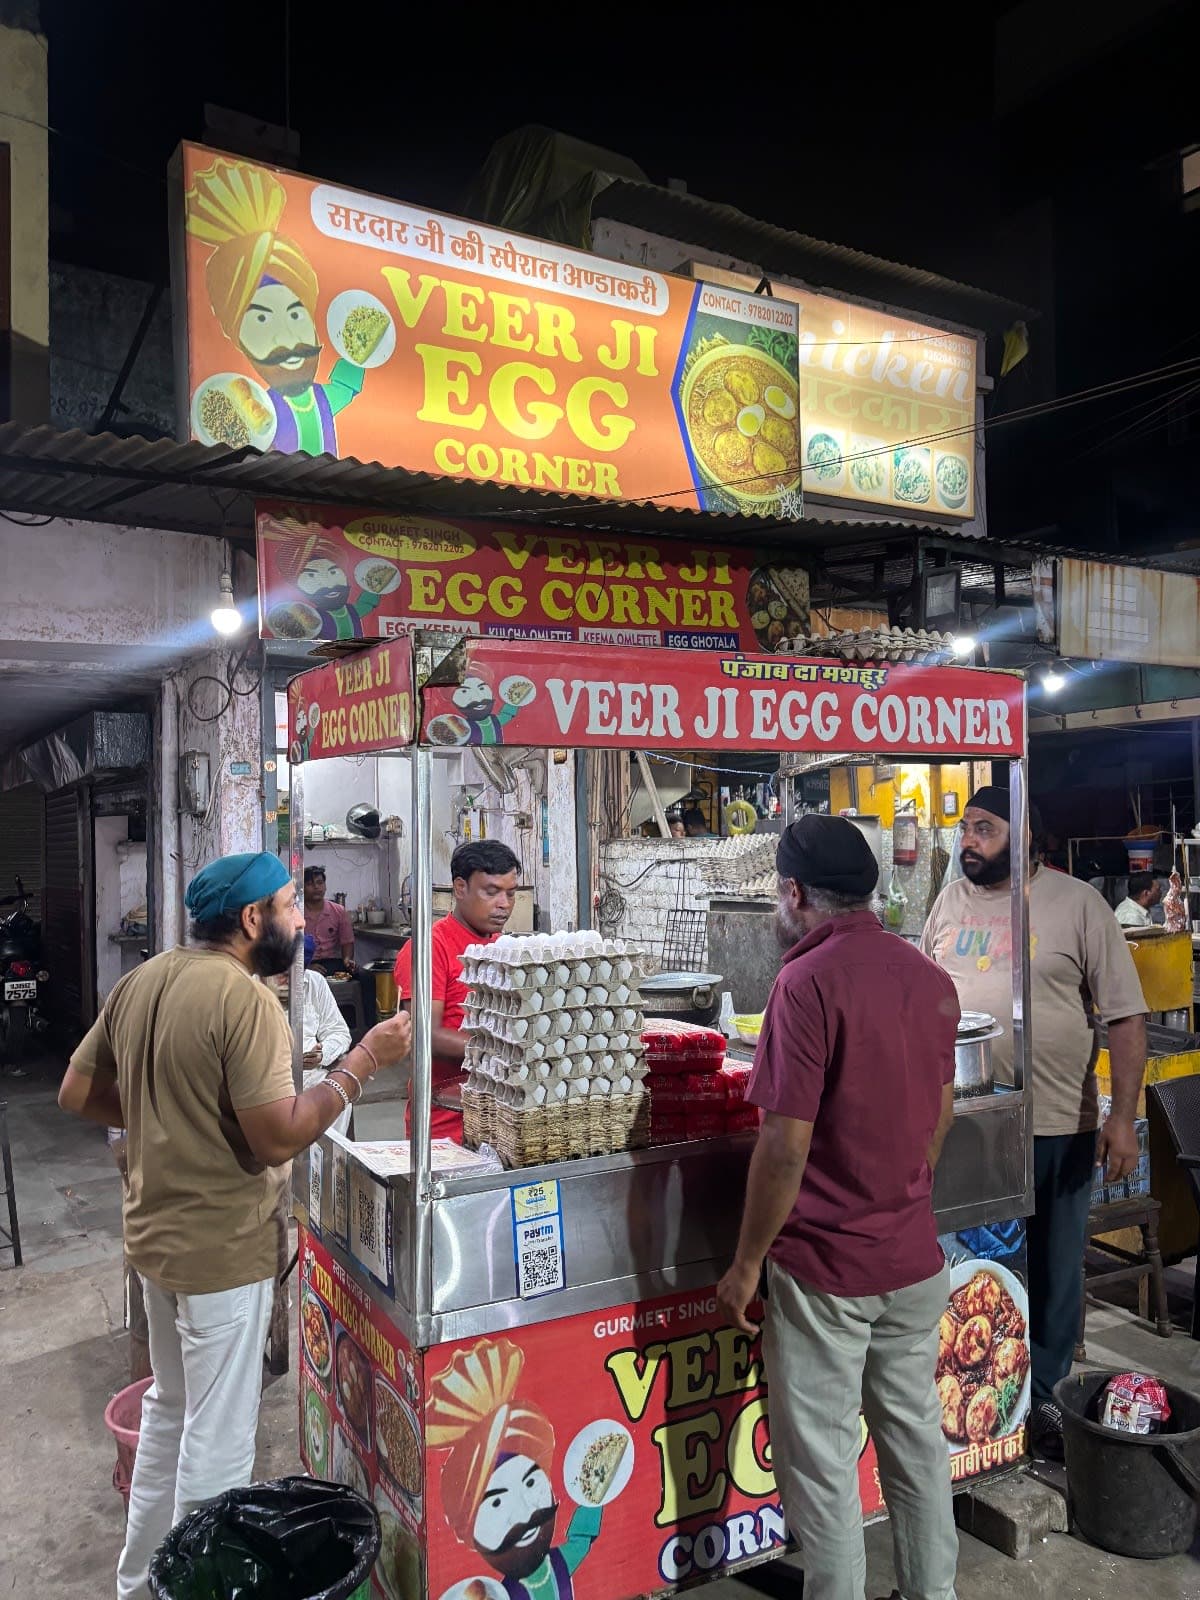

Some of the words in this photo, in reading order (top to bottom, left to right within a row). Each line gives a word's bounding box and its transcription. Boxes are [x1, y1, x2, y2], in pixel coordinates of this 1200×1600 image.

[326, 202, 409, 245] सरदार
[413, 220, 445, 254] जी
[449, 230, 484, 265] की
[380, 266, 583, 362] VEER
[597, 320, 659, 376] JI
[703, 292, 741, 313] CONTACT
[748, 303, 793, 326] 9782012202
[414, 343, 636, 452] EGG
[433, 438, 623, 497] CORNER
[358, 535, 403, 548] CONTACT
[411, 540, 464, 554] 9782012202
[362, 522, 421, 538] GURMEET
[423, 528, 460, 541] SINGH
[491, 531, 667, 581] VEER
[678, 549, 732, 585] JI
[405, 568, 528, 618] EGG
[540, 579, 740, 629] CORNER
[385, 622, 416, 635] EGG
[584, 631, 614, 644] KEEMA
[616, 633, 657, 646] OMLETTE
[668, 634, 688, 647] EGG
[691, 635, 737, 648] GHOTALA
[335, 657, 373, 697] VEER
[375, 649, 391, 687] JI
[721, 656, 790, 681] पंजाब
[793, 664, 819, 681] दा
[821, 665, 887, 690] मशहूर
[321, 707, 347, 749] EGG
[349, 692, 411, 744] CORNER
[546, 678, 683, 739] VEER
[693, 686, 740, 739] JI
[750, 689, 841, 742] EGG
[851, 694, 1012, 745] CORNER
[7, 989, 36, 999] 7575
[315, 1260, 333, 1307] VEER
[334, 1283, 342, 1317] JI
[342, 1298, 358, 1335] EGG
[359, 1312, 396, 1381] CORNER
[593, 1306, 675, 1338] GURMEET
[677, 1297, 717, 1322] SING
[604, 1325, 768, 1423] VEE
[651, 1396, 781, 1529] EG
[658, 1502, 789, 1584] CORN
